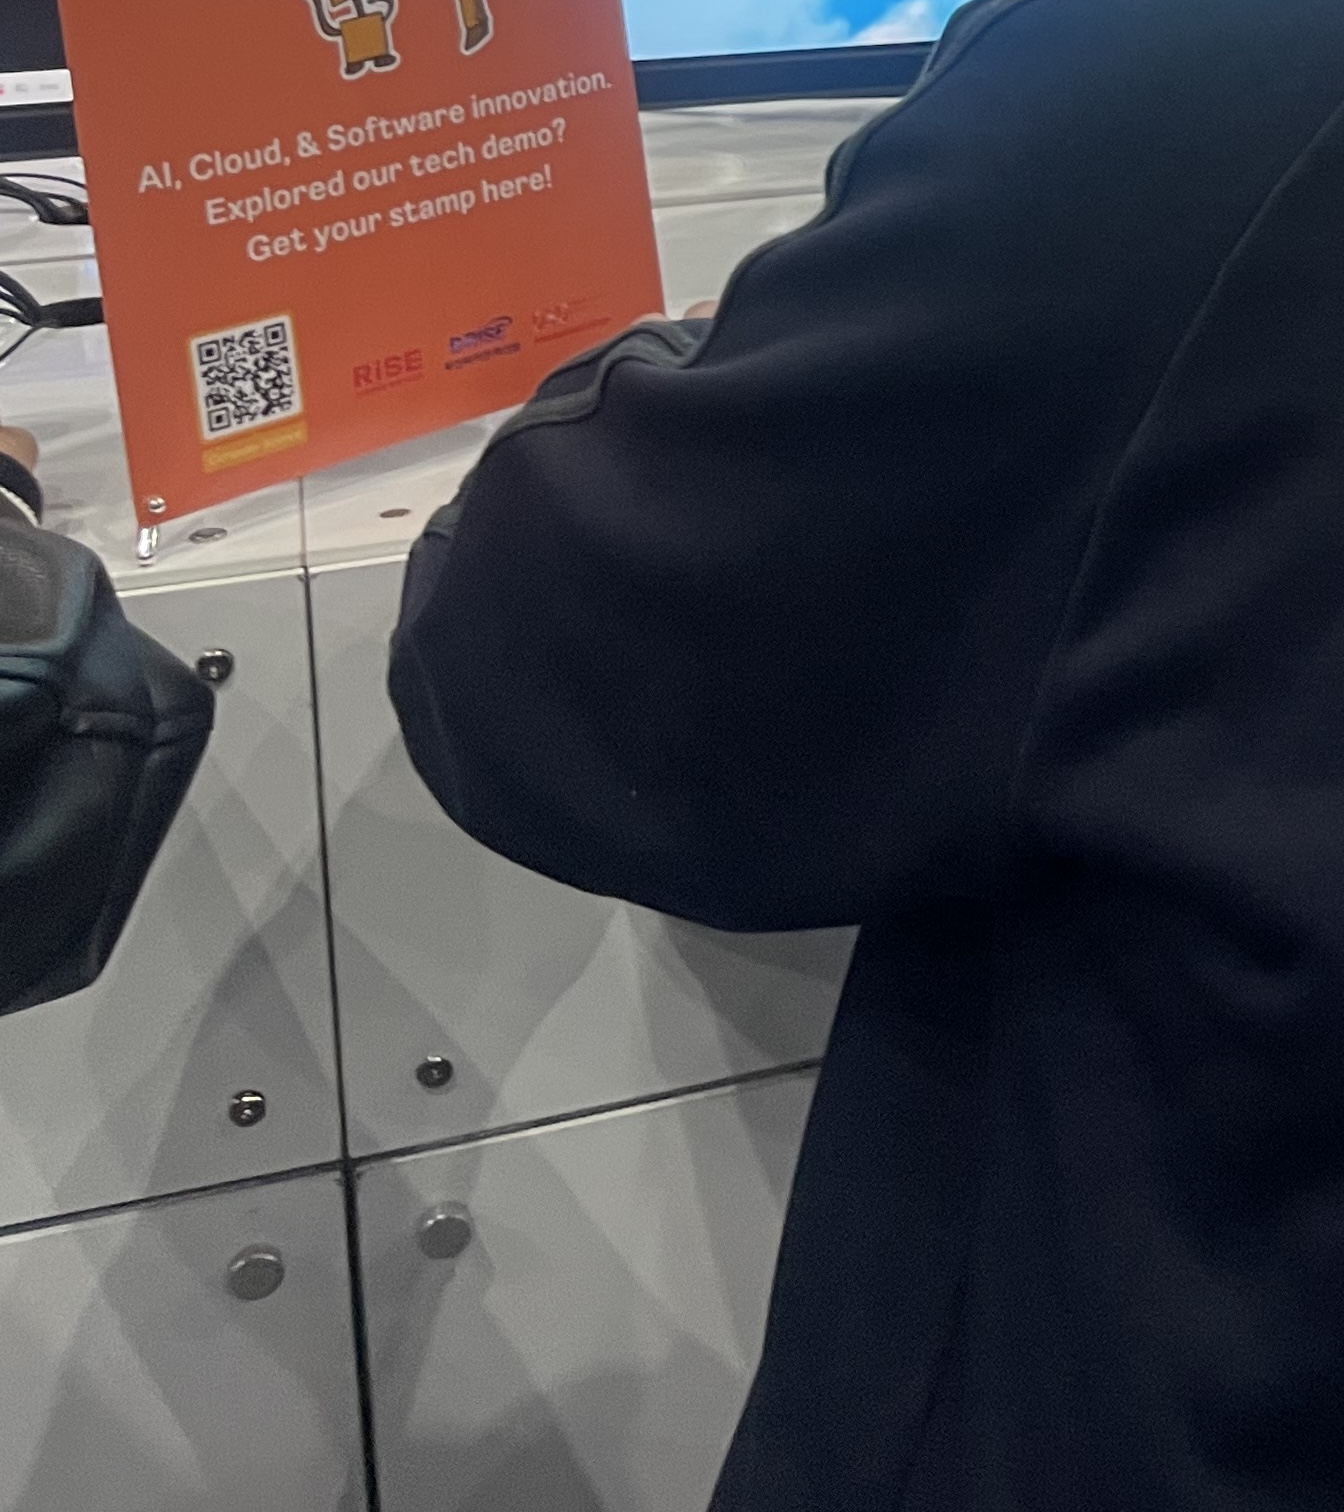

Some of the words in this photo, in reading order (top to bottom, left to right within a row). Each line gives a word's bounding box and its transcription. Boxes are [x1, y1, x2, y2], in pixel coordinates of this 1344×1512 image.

[138, 163, 182, 195] AI,
[188, 138, 292, 184] Cloud,
[297, 133, 322, 159] &
[327, 102, 466, 153] Software
[470, 71, 614, 120] innovation.
[205, 170, 346, 227] Explored
[353, 162, 403, 191] our
[409, 143, 476, 180] tech
[481, 119, 568, 159] demo?
[247, 229, 308, 264] Get
[314, 212, 383, 253] your
[389, 190, 478, 235] stamp
[481, 164, 554, 204] here!
